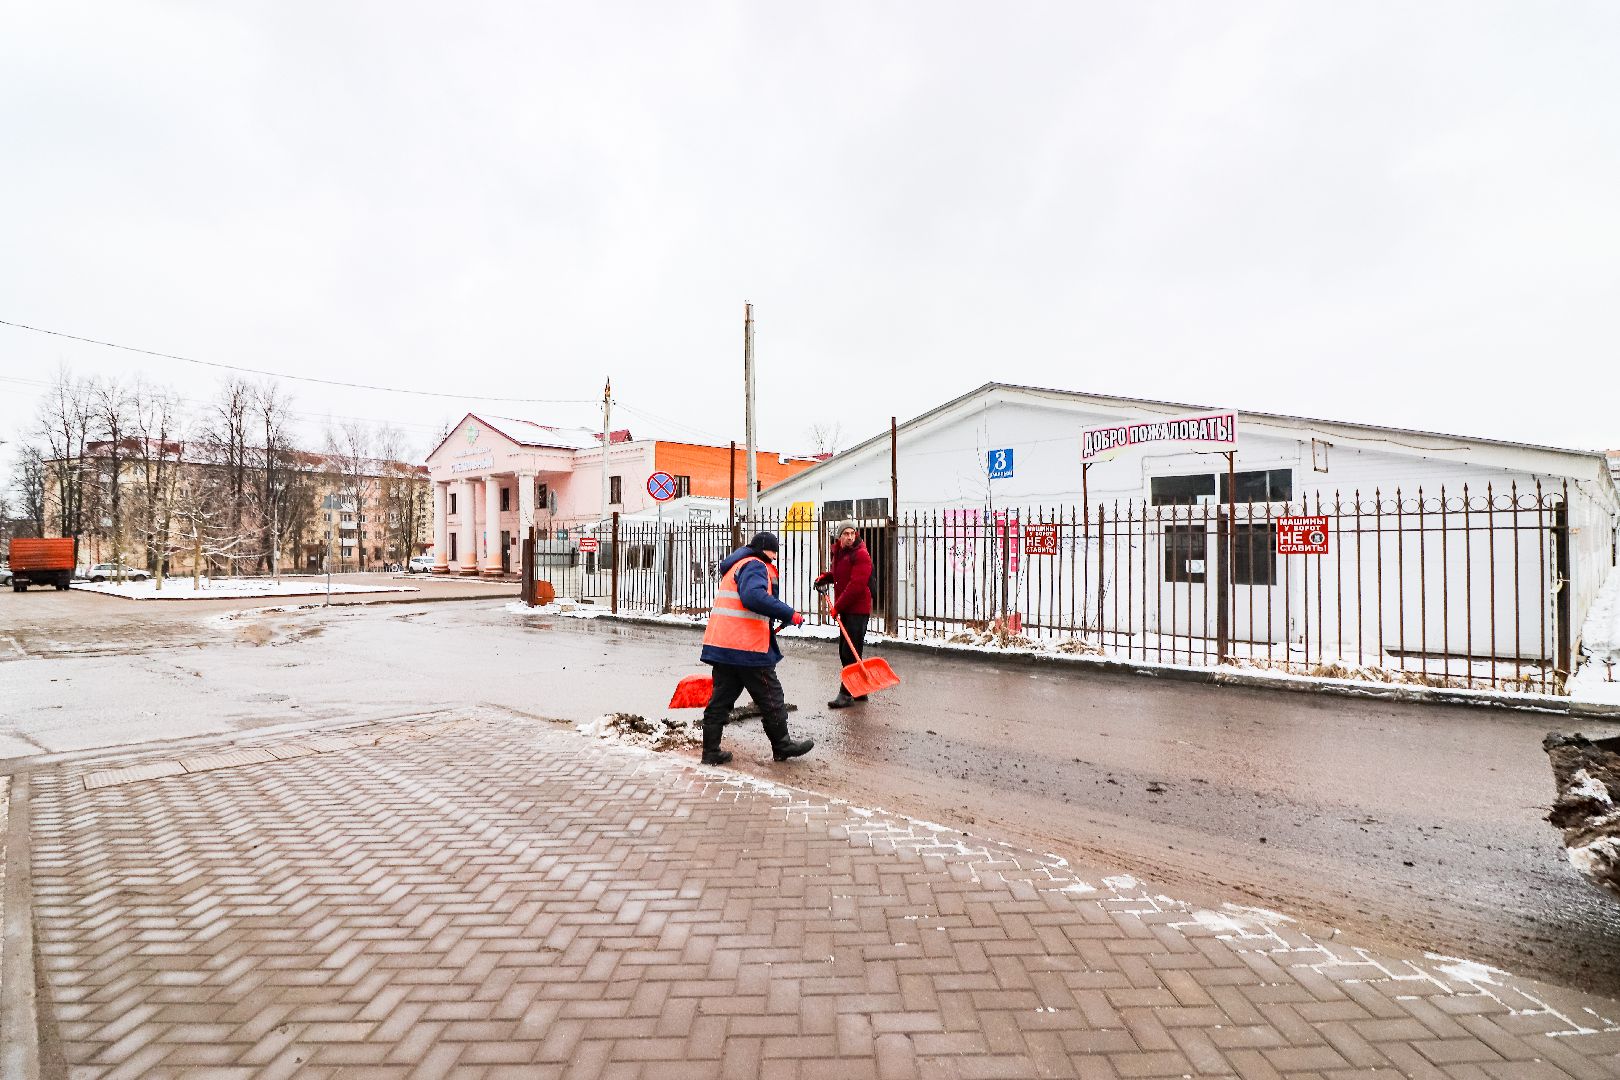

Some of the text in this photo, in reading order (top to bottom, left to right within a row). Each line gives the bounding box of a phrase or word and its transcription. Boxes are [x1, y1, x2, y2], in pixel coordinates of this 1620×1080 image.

[1083, 415, 1234, 458] ДОБРО ПОЖАЛОВАТЬ!
[1026, 537, 1041, 547] НЕ
[1280, 532, 1303, 544] НЕ
